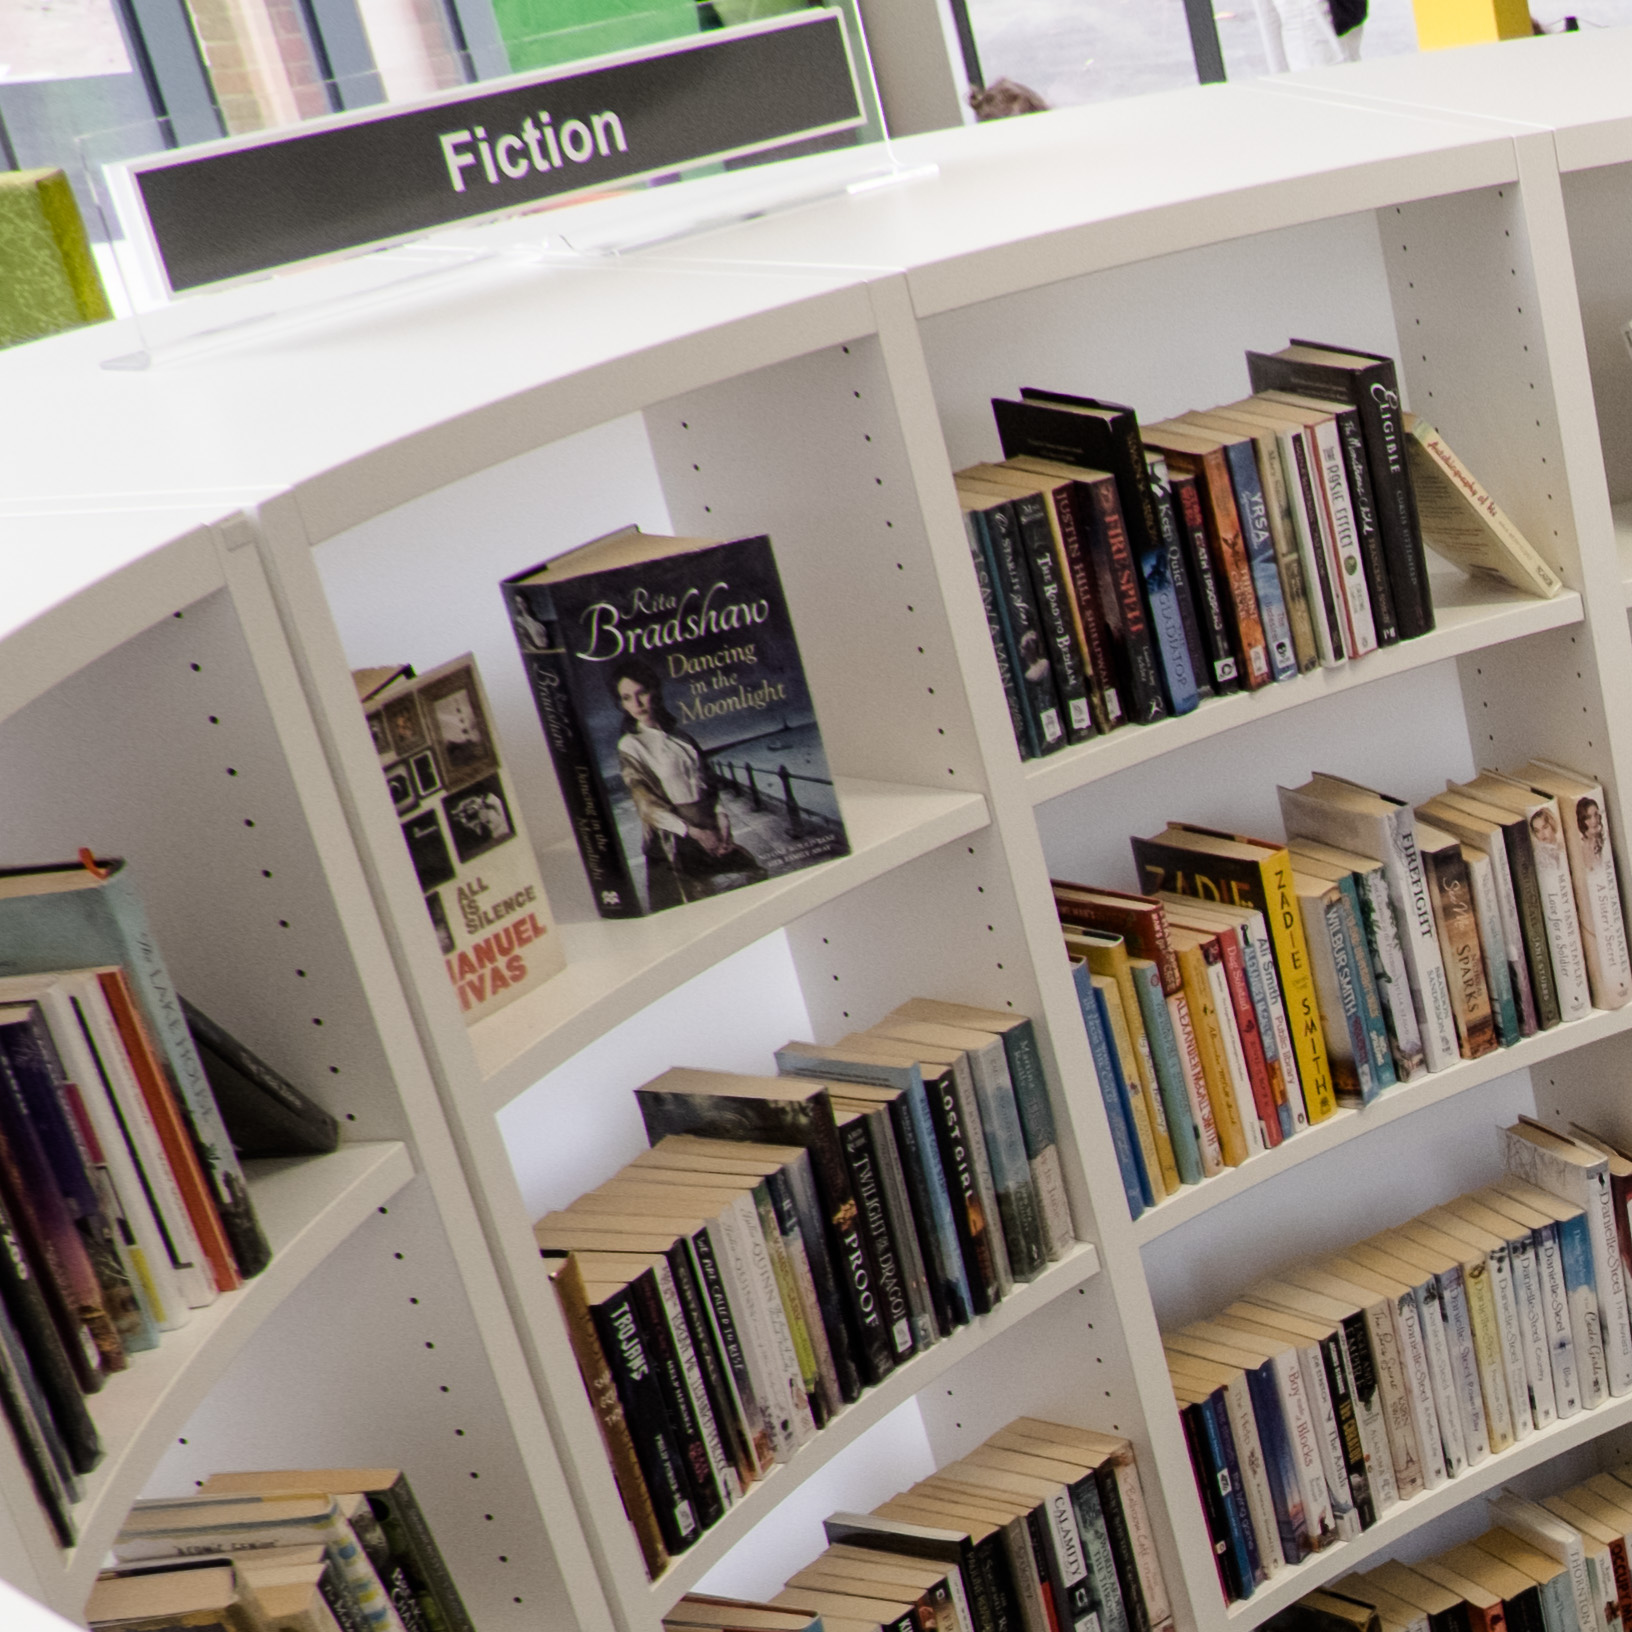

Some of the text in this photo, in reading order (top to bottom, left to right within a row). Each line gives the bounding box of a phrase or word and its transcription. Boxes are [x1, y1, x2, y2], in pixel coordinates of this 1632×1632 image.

[439, 108, 628, 194] Fiction
[1370, 382, 1401, 474] ELIGIBLE
[1249, 491, 1271, 543] YRSA
[575, 581, 770, 663] Bradshaw
[628, 587, 680, 622] Rita
[667, 643, 756, 679] Dancing
[690, 670, 739, 696] in the
[679, 682, 787, 725] Moonlight
[455, 876, 490, 902] ALL
[461, 897, 481, 919] IS
[465, 885, 537, 936] SILENCE
[1274, 870, 1303, 970] ZADIE
[1402, 832, 1433, 939] FIREFIGHT
[1325, 908, 1357, 1015] WILBUR SMITH
[1456, 944, 1479, 1014] SPARKS
[1302, 1000, 1328, 1097] SMITH
[939, 1080, 973, 1198] LOST GIRL
[845, 1233, 880, 1327] PROOF
[1600, 1190, 1624, 1295] Danielle Steel
[610, 1302, 649, 1382] TROJANS
[1054, 1497, 1082, 1578] CALAMITY
[1570, 1551, 1591, 1625] THORNTON
